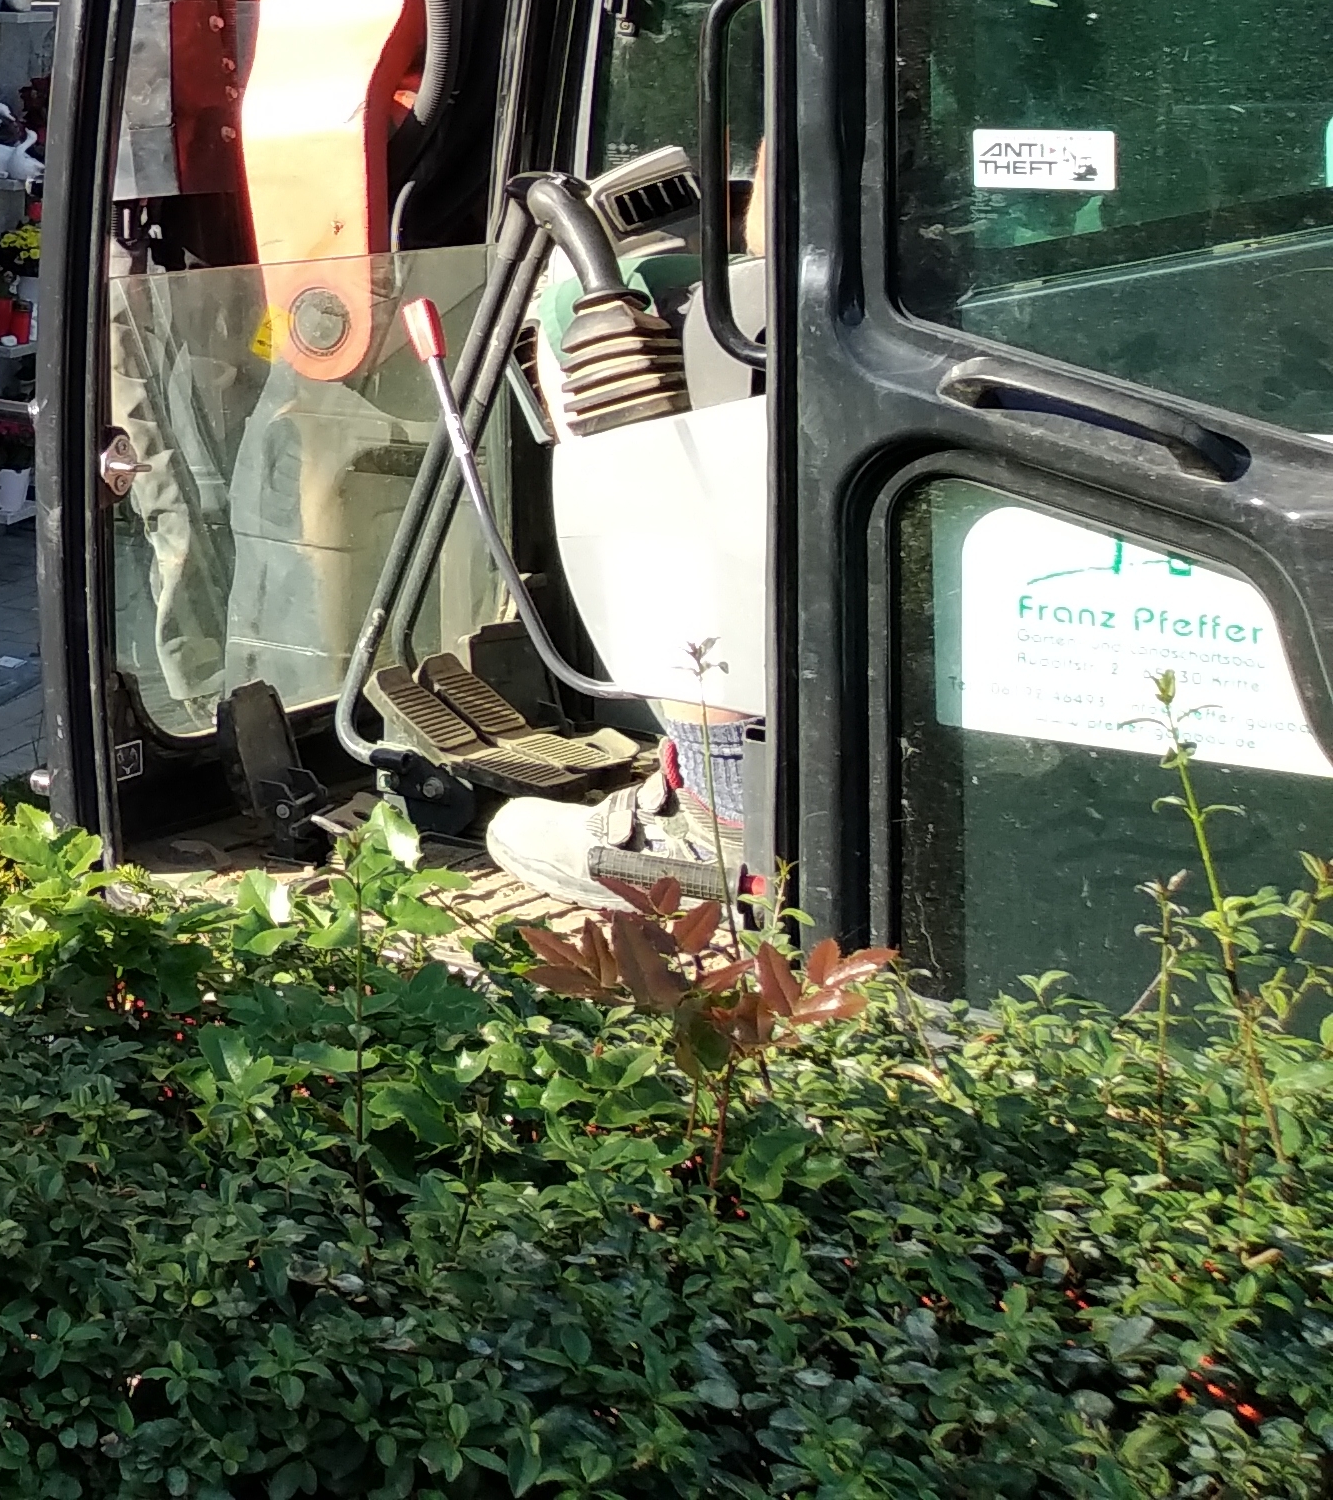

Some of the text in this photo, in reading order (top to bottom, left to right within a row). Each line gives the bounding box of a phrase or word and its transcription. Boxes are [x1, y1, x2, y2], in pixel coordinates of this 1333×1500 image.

[979, 143, 1045, 158] ANTI
[978, 160, 1059, 176] THEFT
[1018, 594, 1264, 645] Franz Pfeffer
[1110, 662, 1119, 675] 2
[1143, 665, 1203, 686] 6530
